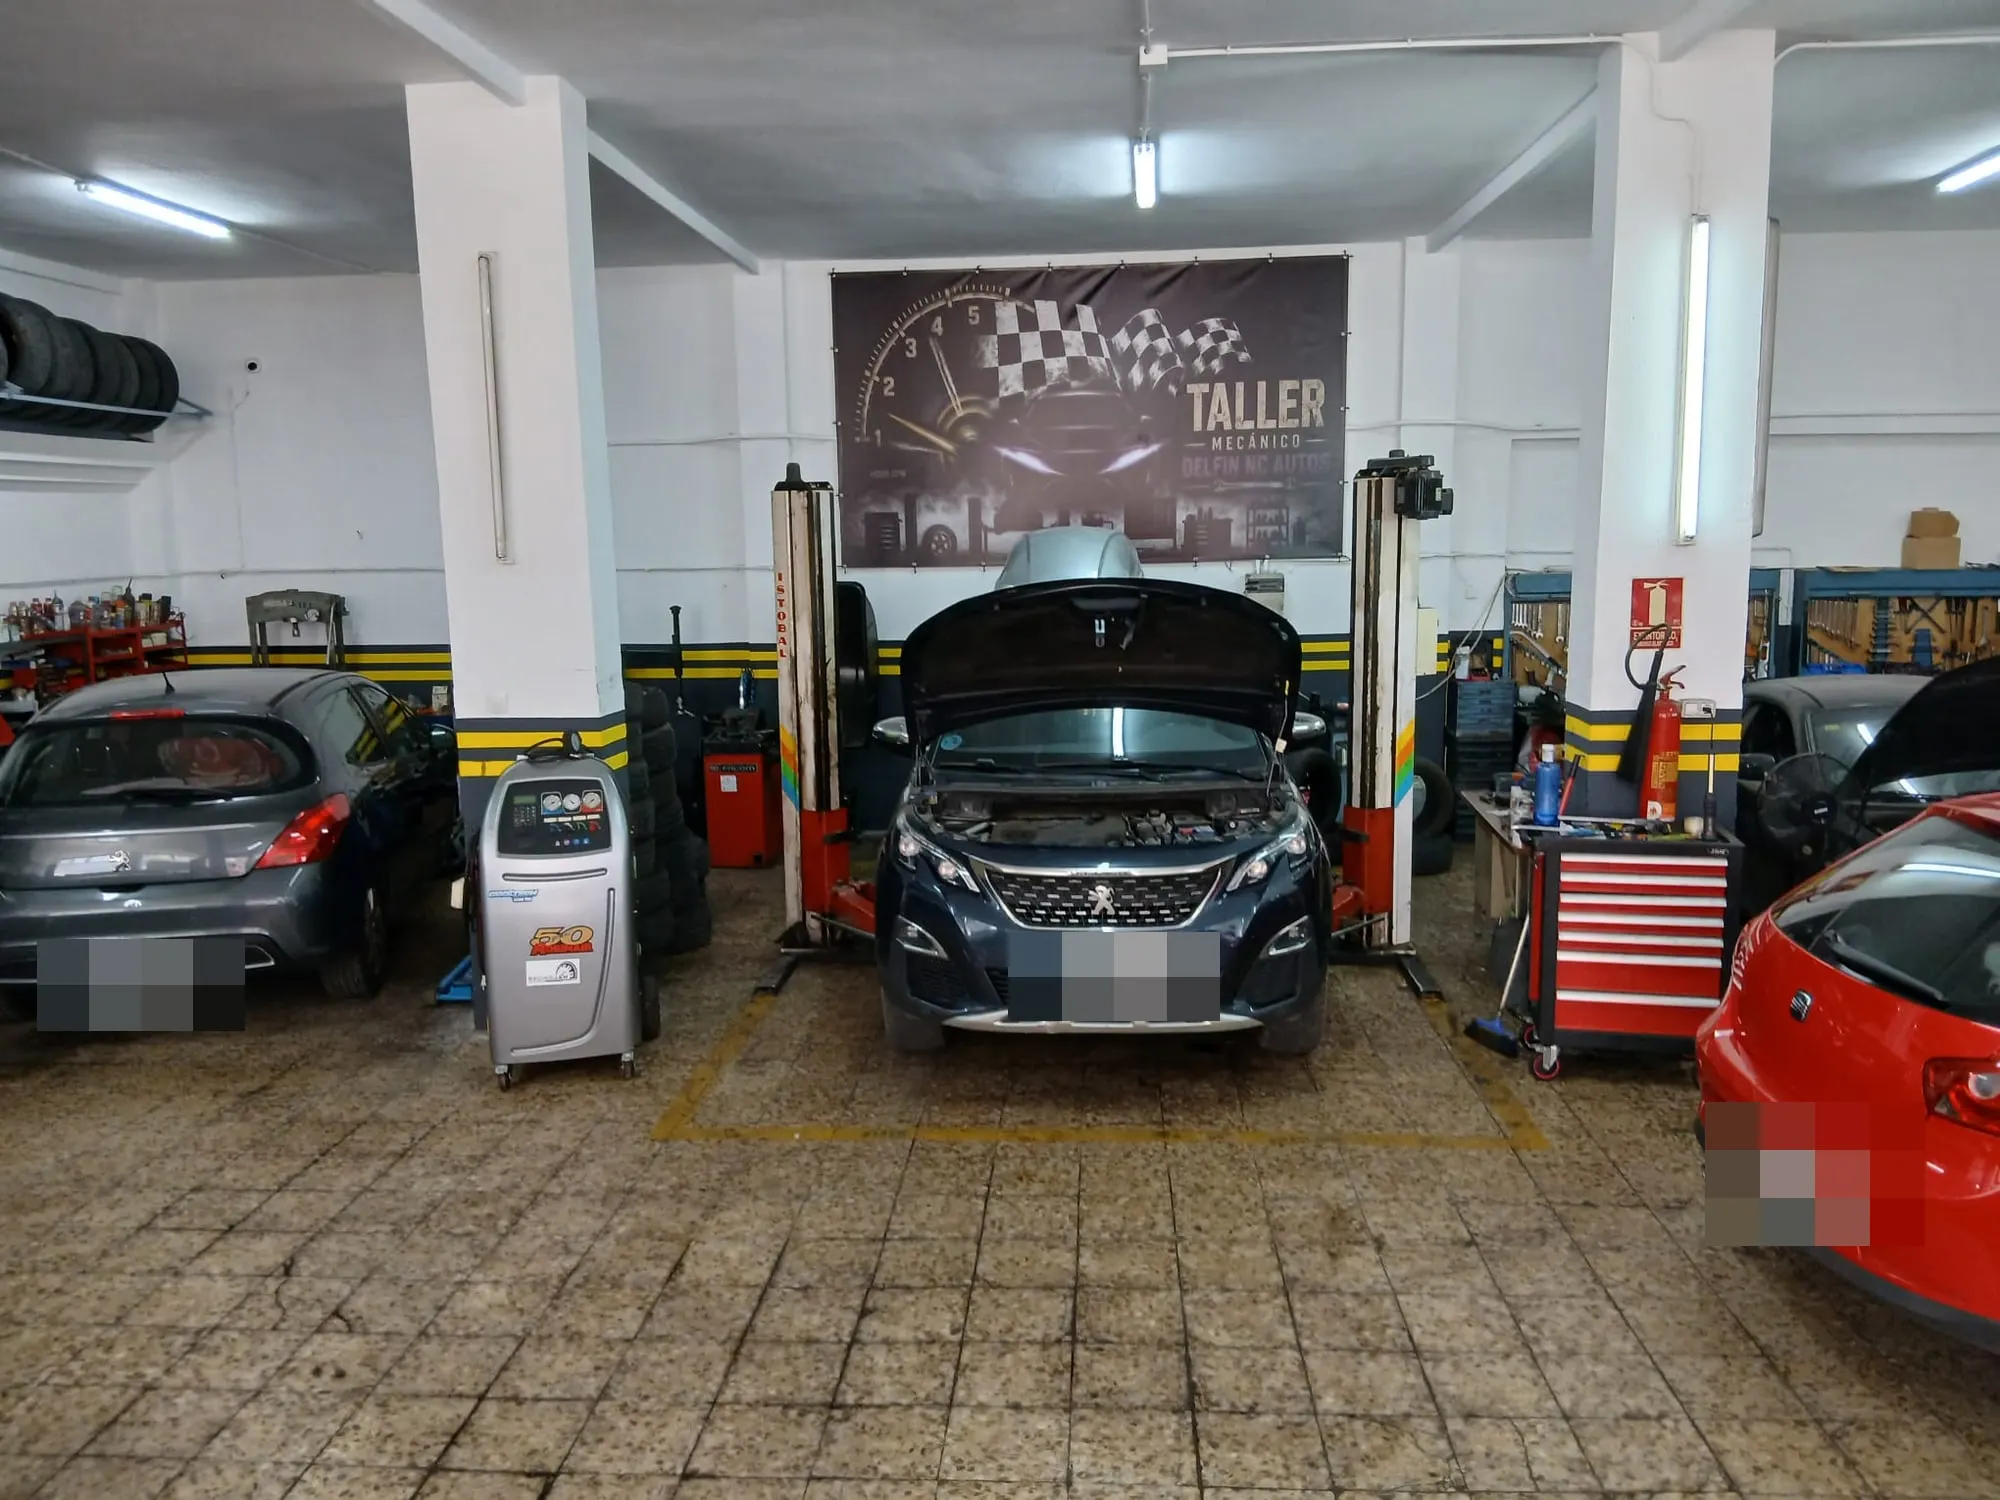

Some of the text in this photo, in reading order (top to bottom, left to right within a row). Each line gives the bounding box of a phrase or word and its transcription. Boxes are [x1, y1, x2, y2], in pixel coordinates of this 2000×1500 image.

[931, 316, 943, 336] 4
[968, 306, 980, 325] 5
[905, 337, 917, 358] 3
[883, 376, 895, 397] 2
[1186, 379, 1326, 432] TALLER
[874, 429, 882, 447] 1
[1212, 432, 1300, 451] MECÁNICO
[776, 572, 788, 658] ISTOBAL
[529, 925, 594, 946] 50
